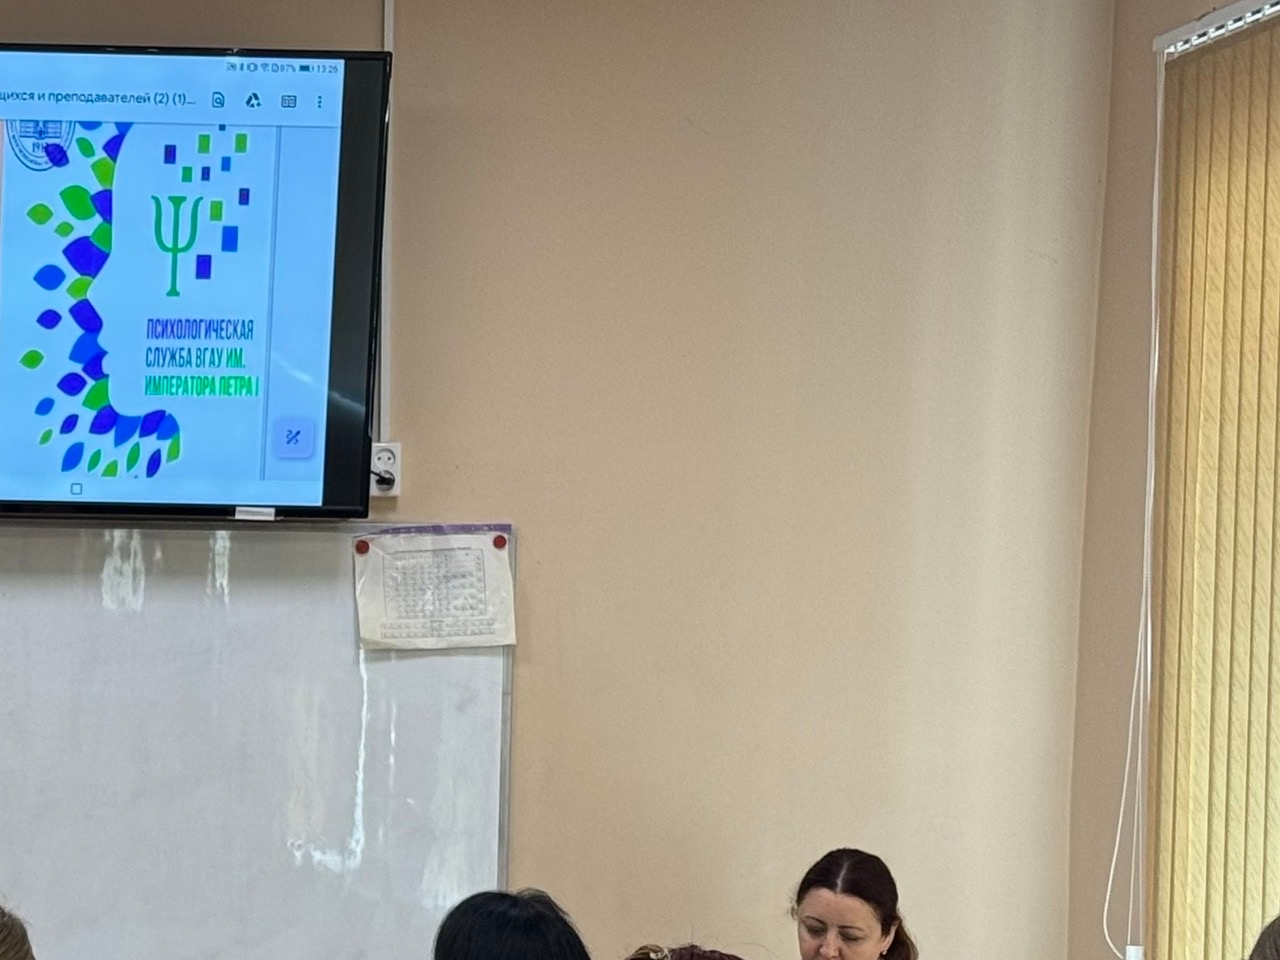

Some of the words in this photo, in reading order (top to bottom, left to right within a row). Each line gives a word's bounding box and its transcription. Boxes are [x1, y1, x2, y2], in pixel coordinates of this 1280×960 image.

[316, 64, 339, 74] 13:26
[37, 92, 46, 100] и
[49, 90, 150, 105] преподавателей
[153, 92, 170, 106] (2)
[147, 318, 254, 340] ПСИХОЛОГИЧЕСКАЯ
[145, 347, 192, 368] СЛУЖБА
[195, 347, 224, 368] ВГАУ
[226, 347, 246, 368] ИМ.
[144, 375, 216, 396] ИМПЕРАТОРА
[219, 376, 253, 397] ПЕТРА
